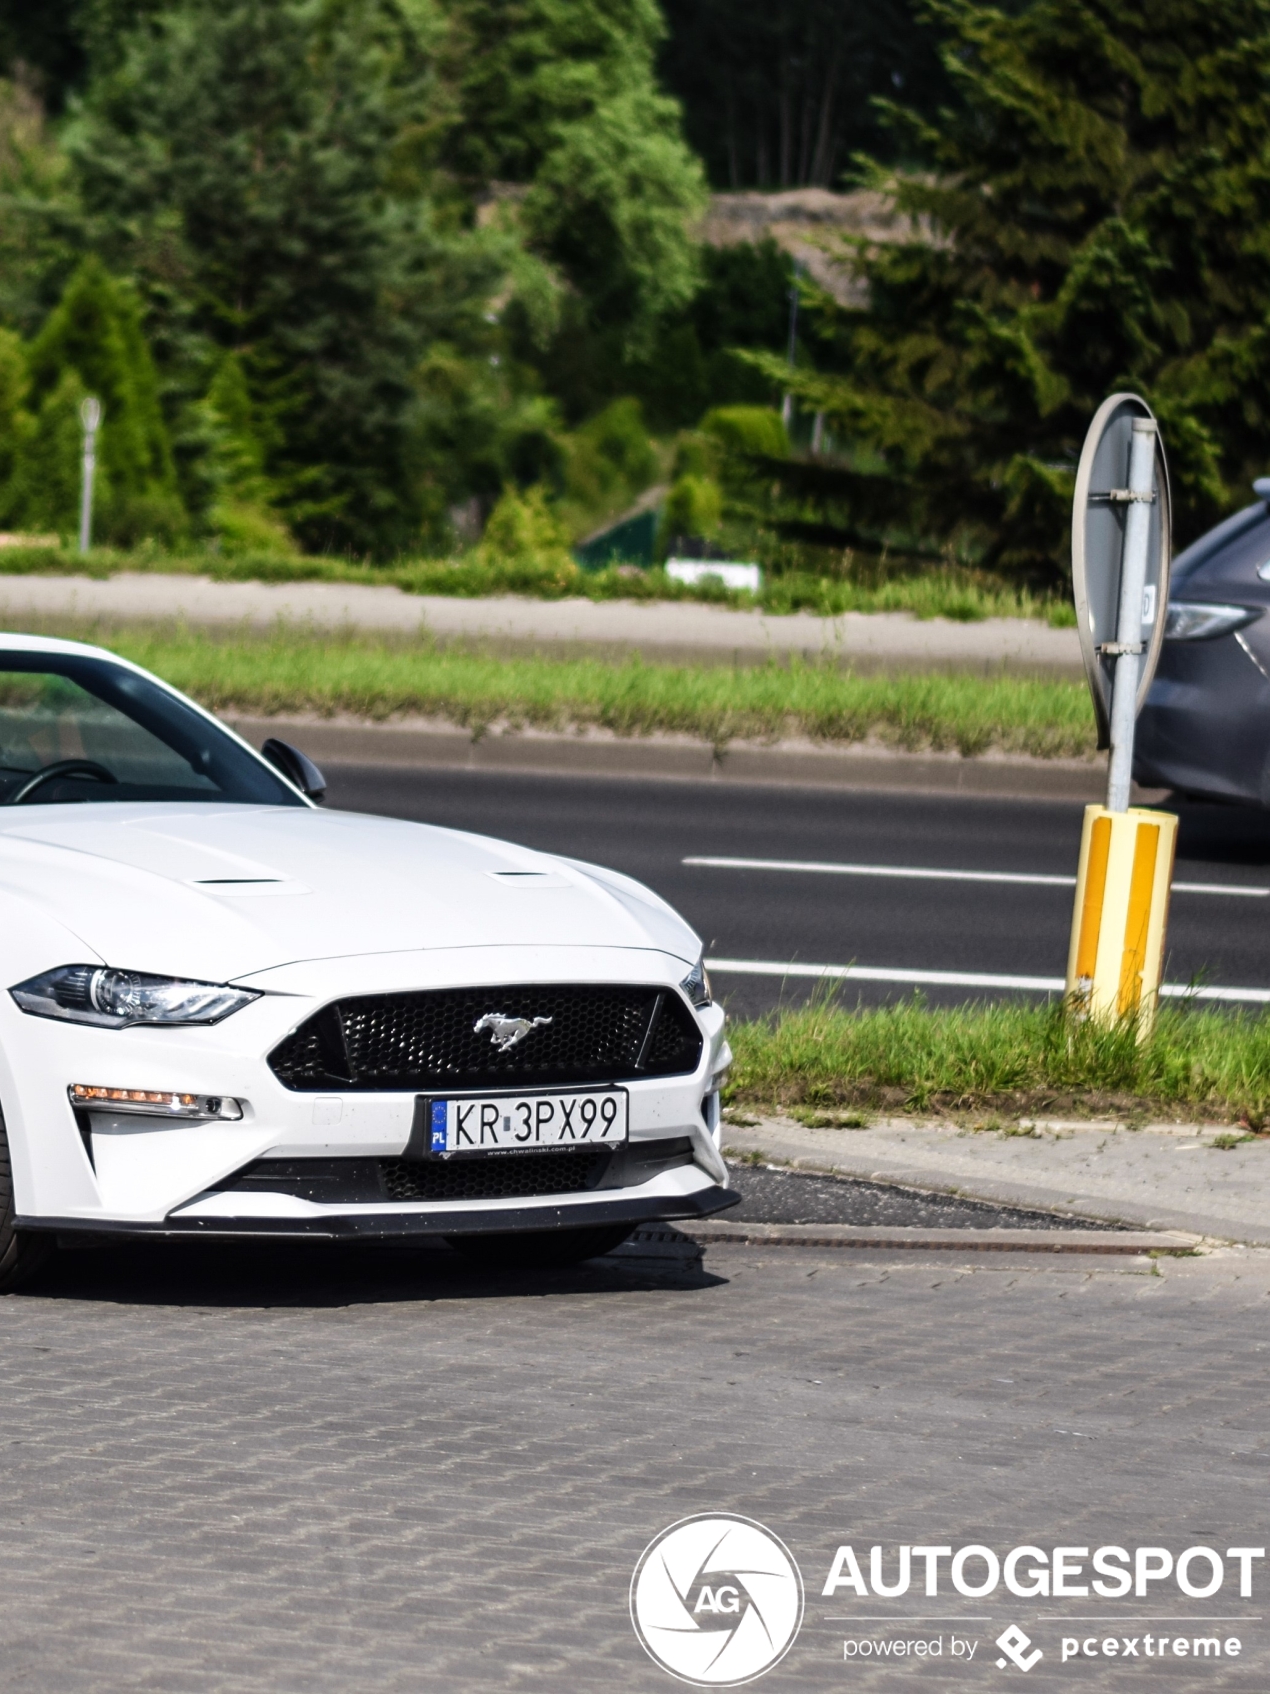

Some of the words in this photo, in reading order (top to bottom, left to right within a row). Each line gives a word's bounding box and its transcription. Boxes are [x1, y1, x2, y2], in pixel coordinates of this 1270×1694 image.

[456, 1103, 499, 1145] KR
[514, 1097, 617, 1142] 3PX99
[432, 1132, 445, 1144] PL
[487, 1145, 576, 1156] www.chwalinski.com.pl
